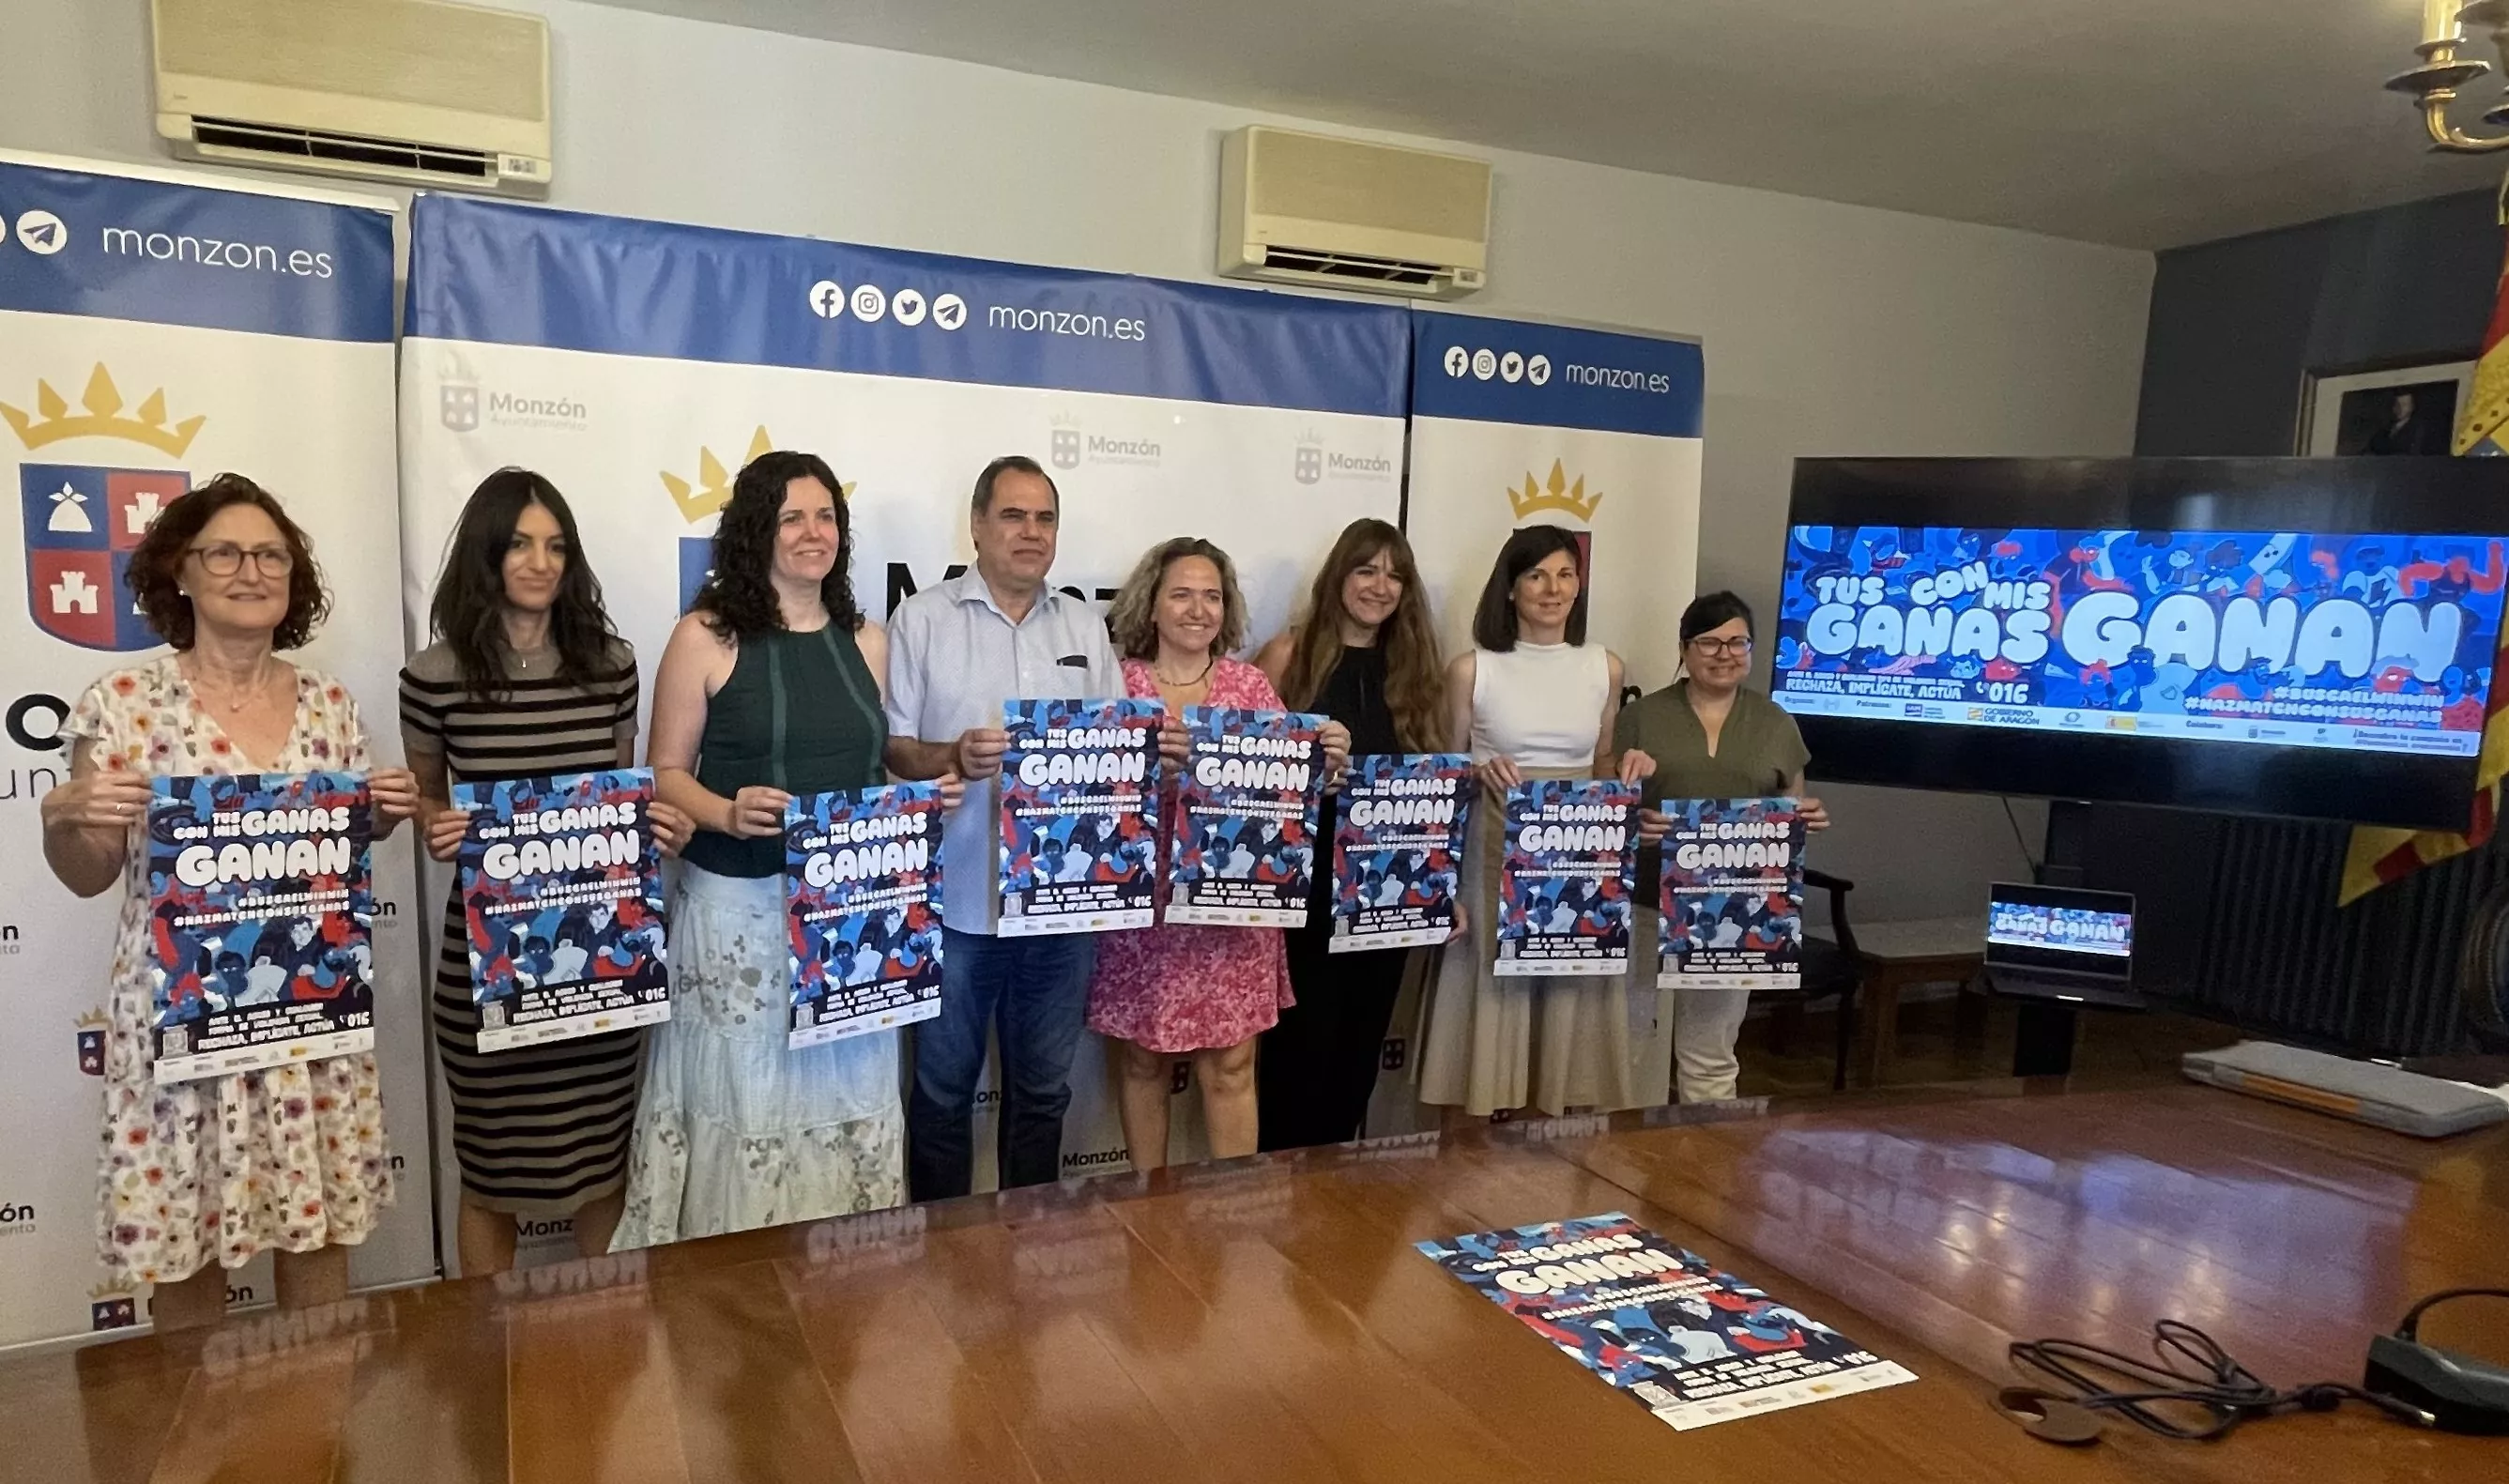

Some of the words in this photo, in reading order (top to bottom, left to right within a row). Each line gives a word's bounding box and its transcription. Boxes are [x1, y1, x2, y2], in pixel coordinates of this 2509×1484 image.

[103, 227, 332, 278] monzon.es
[988, 304, 1145, 342] monzon.es
[1566, 364, 1670, 393] monzon.es
[489, 391, 587, 419] Monzón
[1087, 435, 1161, 458] Monzón
[1327, 451, 1391, 473] Monzón
[1816, 576, 1885, 605] TUS
[1910, 560, 1990, 605] CON
[1983, 581, 2051, 610] MIS
[1806, 604, 2052, 664] GANAS
[2061, 591, 2462, 682] GANAN
[1988, 682, 2029, 704] 016
[1067, 727, 1146, 750] GANAS
[1240, 736, 1311, 760] GANAS
[1018, 752, 1146, 787] GANAN
[1196, 757, 1309, 792] GANAN
[1390, 778, 1457, 796] GANAS
[241, 806, 350, 836] GANAS
[539, 803, 636, 834] GANAS
[1349, 798, 1455, 827] GANAN
[1560, 804, 1628, 822] GANAS
[849, 812, 927, 843] GANAS
[1519, 825, 1627, 851] GANAN
[1718, 822, 1790, 840] GANAS
[176, 837, 351, 887] GANAN
[483, 829, 640, 880] GANAN
[804, 837, 928, 888] GANAN
[1676, 843, 1790, 869] GANAN
[1530, 1233, 1644, 1262] GANAS
[1495, 1248, 1684, 1295] GANAN
